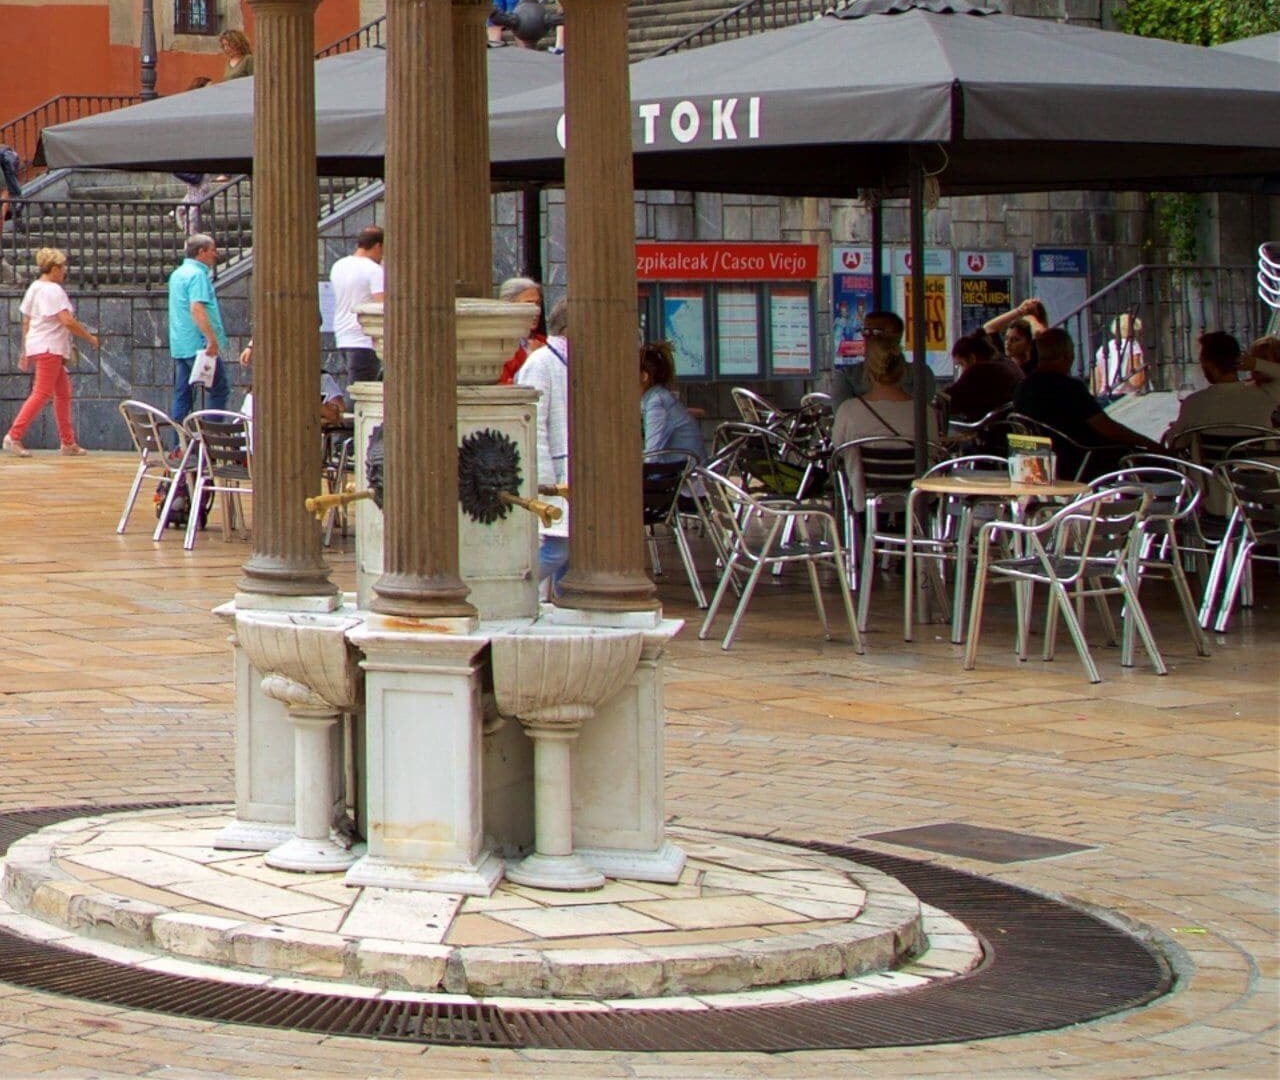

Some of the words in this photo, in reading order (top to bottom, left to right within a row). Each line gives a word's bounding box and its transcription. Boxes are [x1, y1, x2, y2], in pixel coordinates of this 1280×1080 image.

[556, 96, 760, 149] TOKI
[636, 253, 708, 274] zpikaleak
[721, 253, 765, 270] Casco
[768, 253, 807, 273] Viejo
[962, 280, 988, 291] WAR
[962, 292, 1010, 304] REQUIEM
